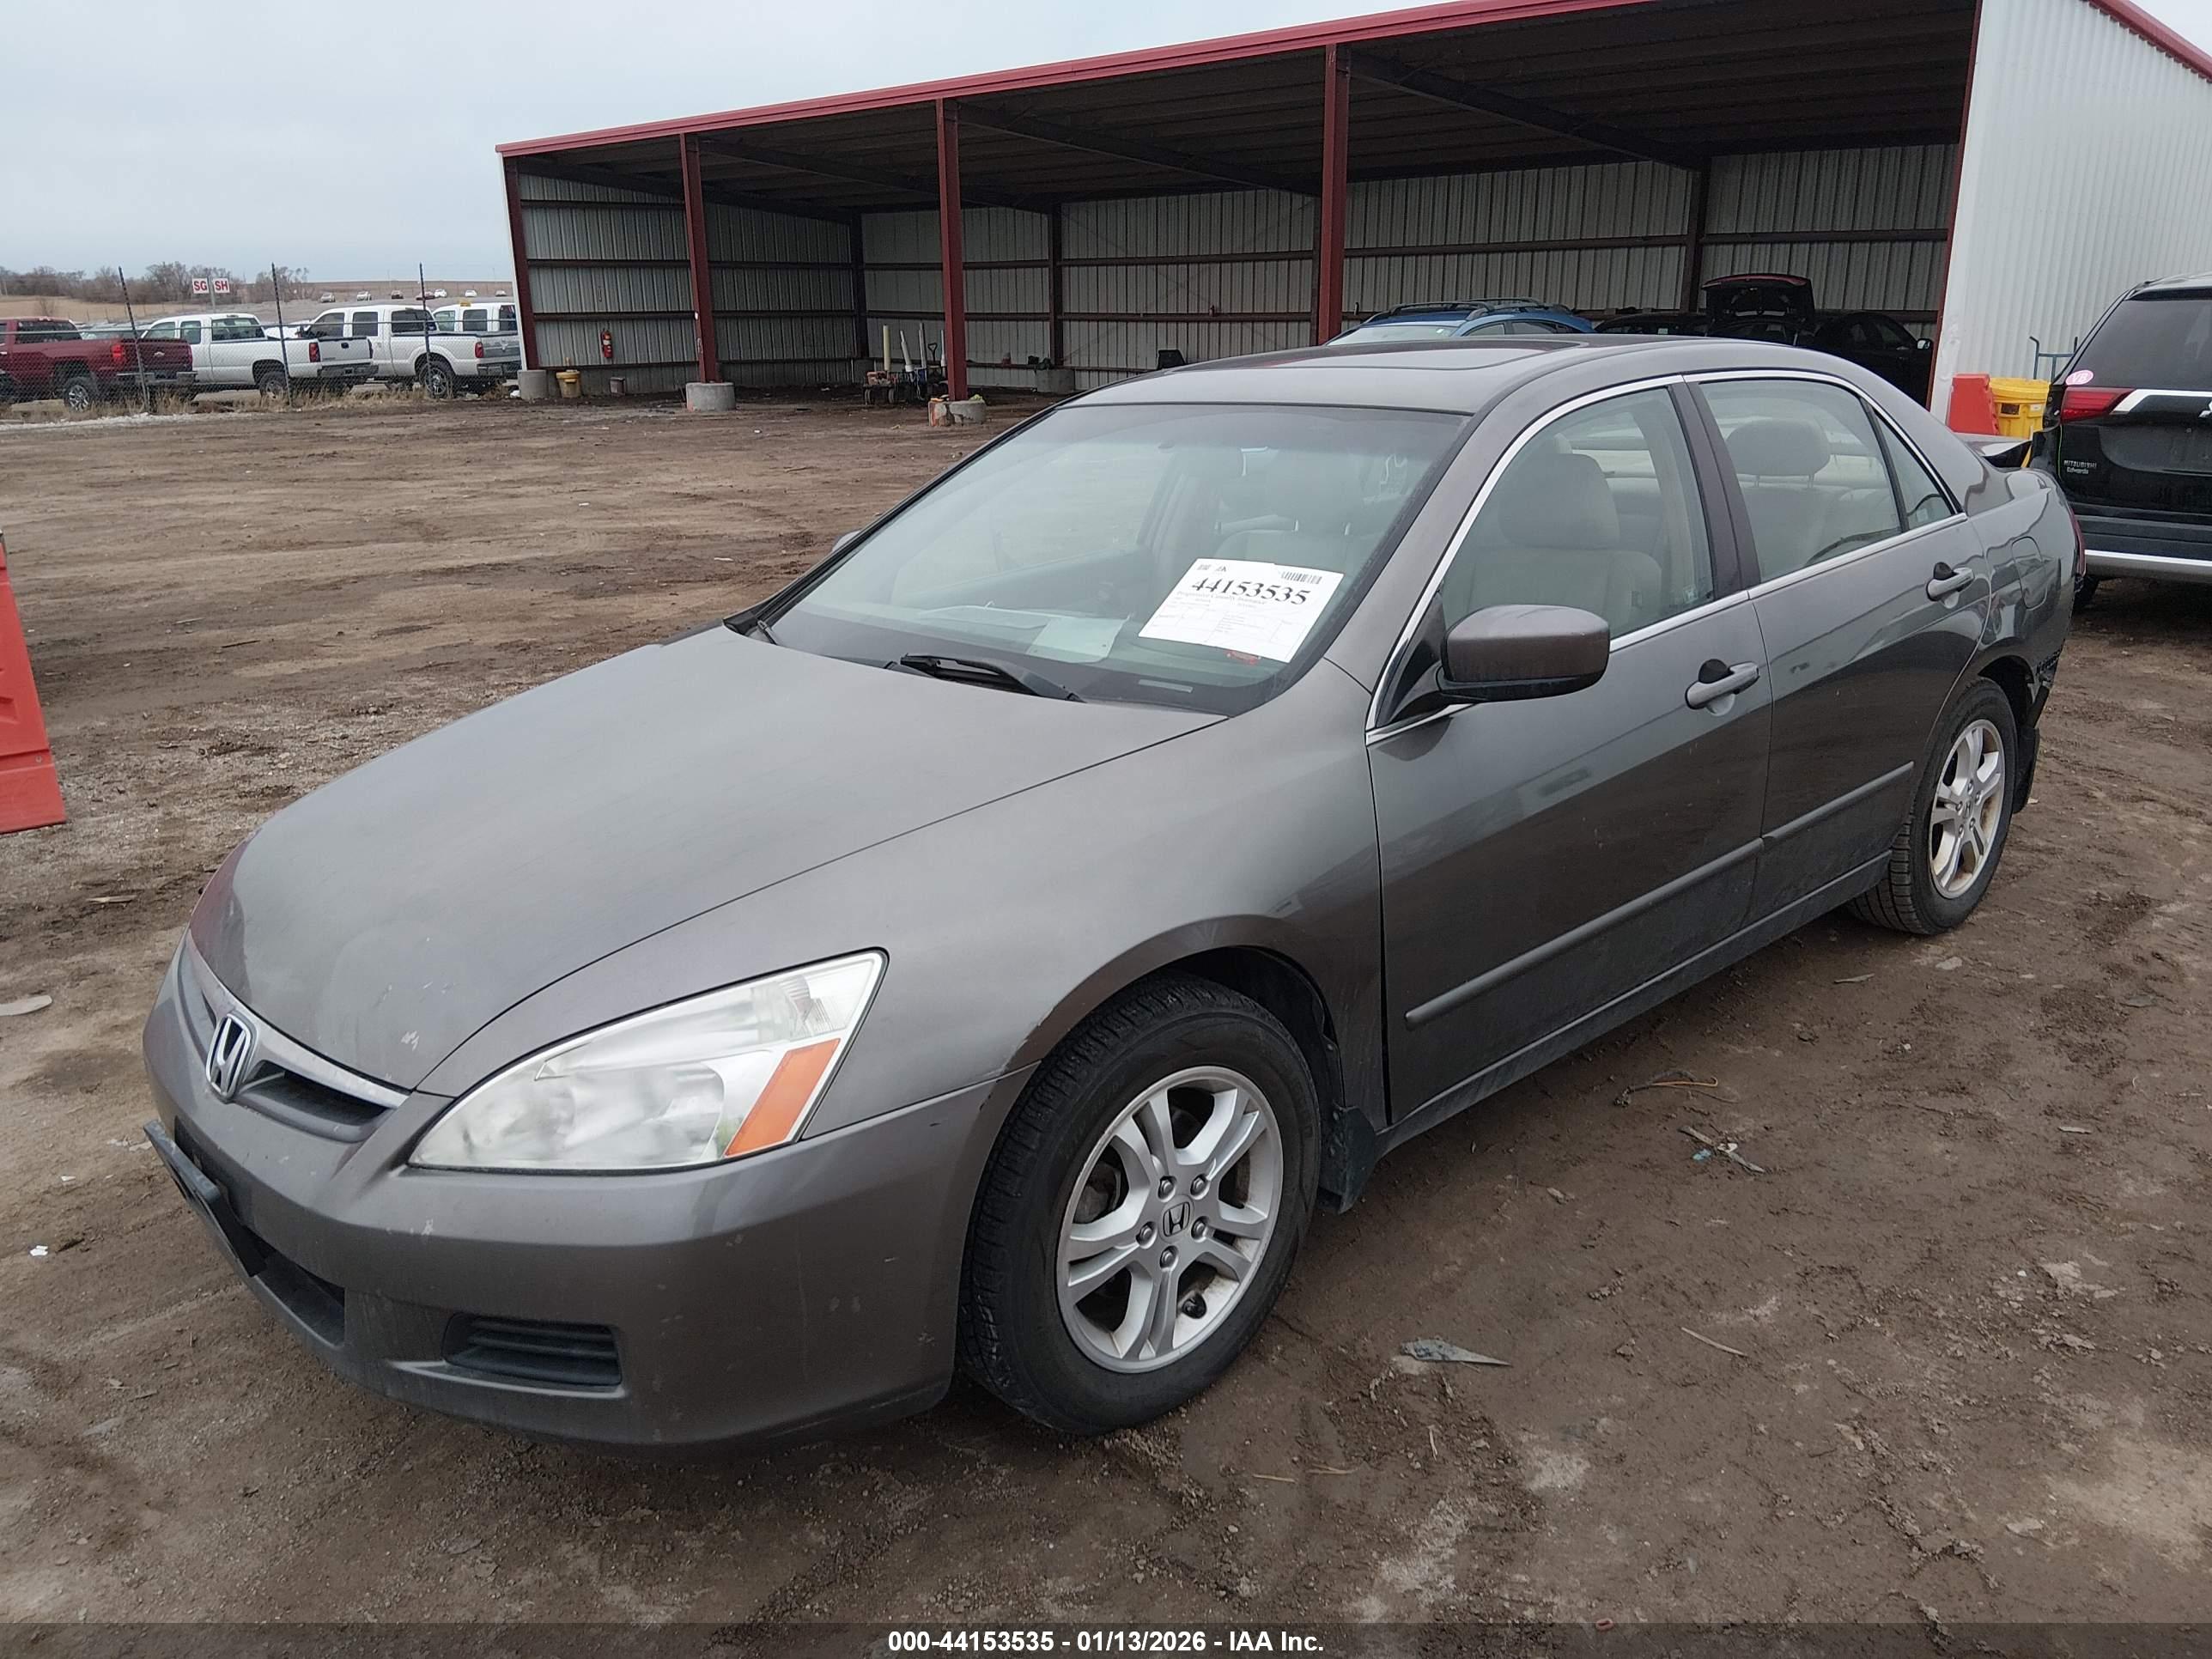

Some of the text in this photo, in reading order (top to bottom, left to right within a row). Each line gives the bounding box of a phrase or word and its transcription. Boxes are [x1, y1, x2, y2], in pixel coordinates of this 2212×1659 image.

[193, 280, 207, 291] SG
[215, 280, 228, 291] SH
[2063, 459, 2097, 468] MITSUBISHI
[1192, 577, 1311, 605] 44153535
